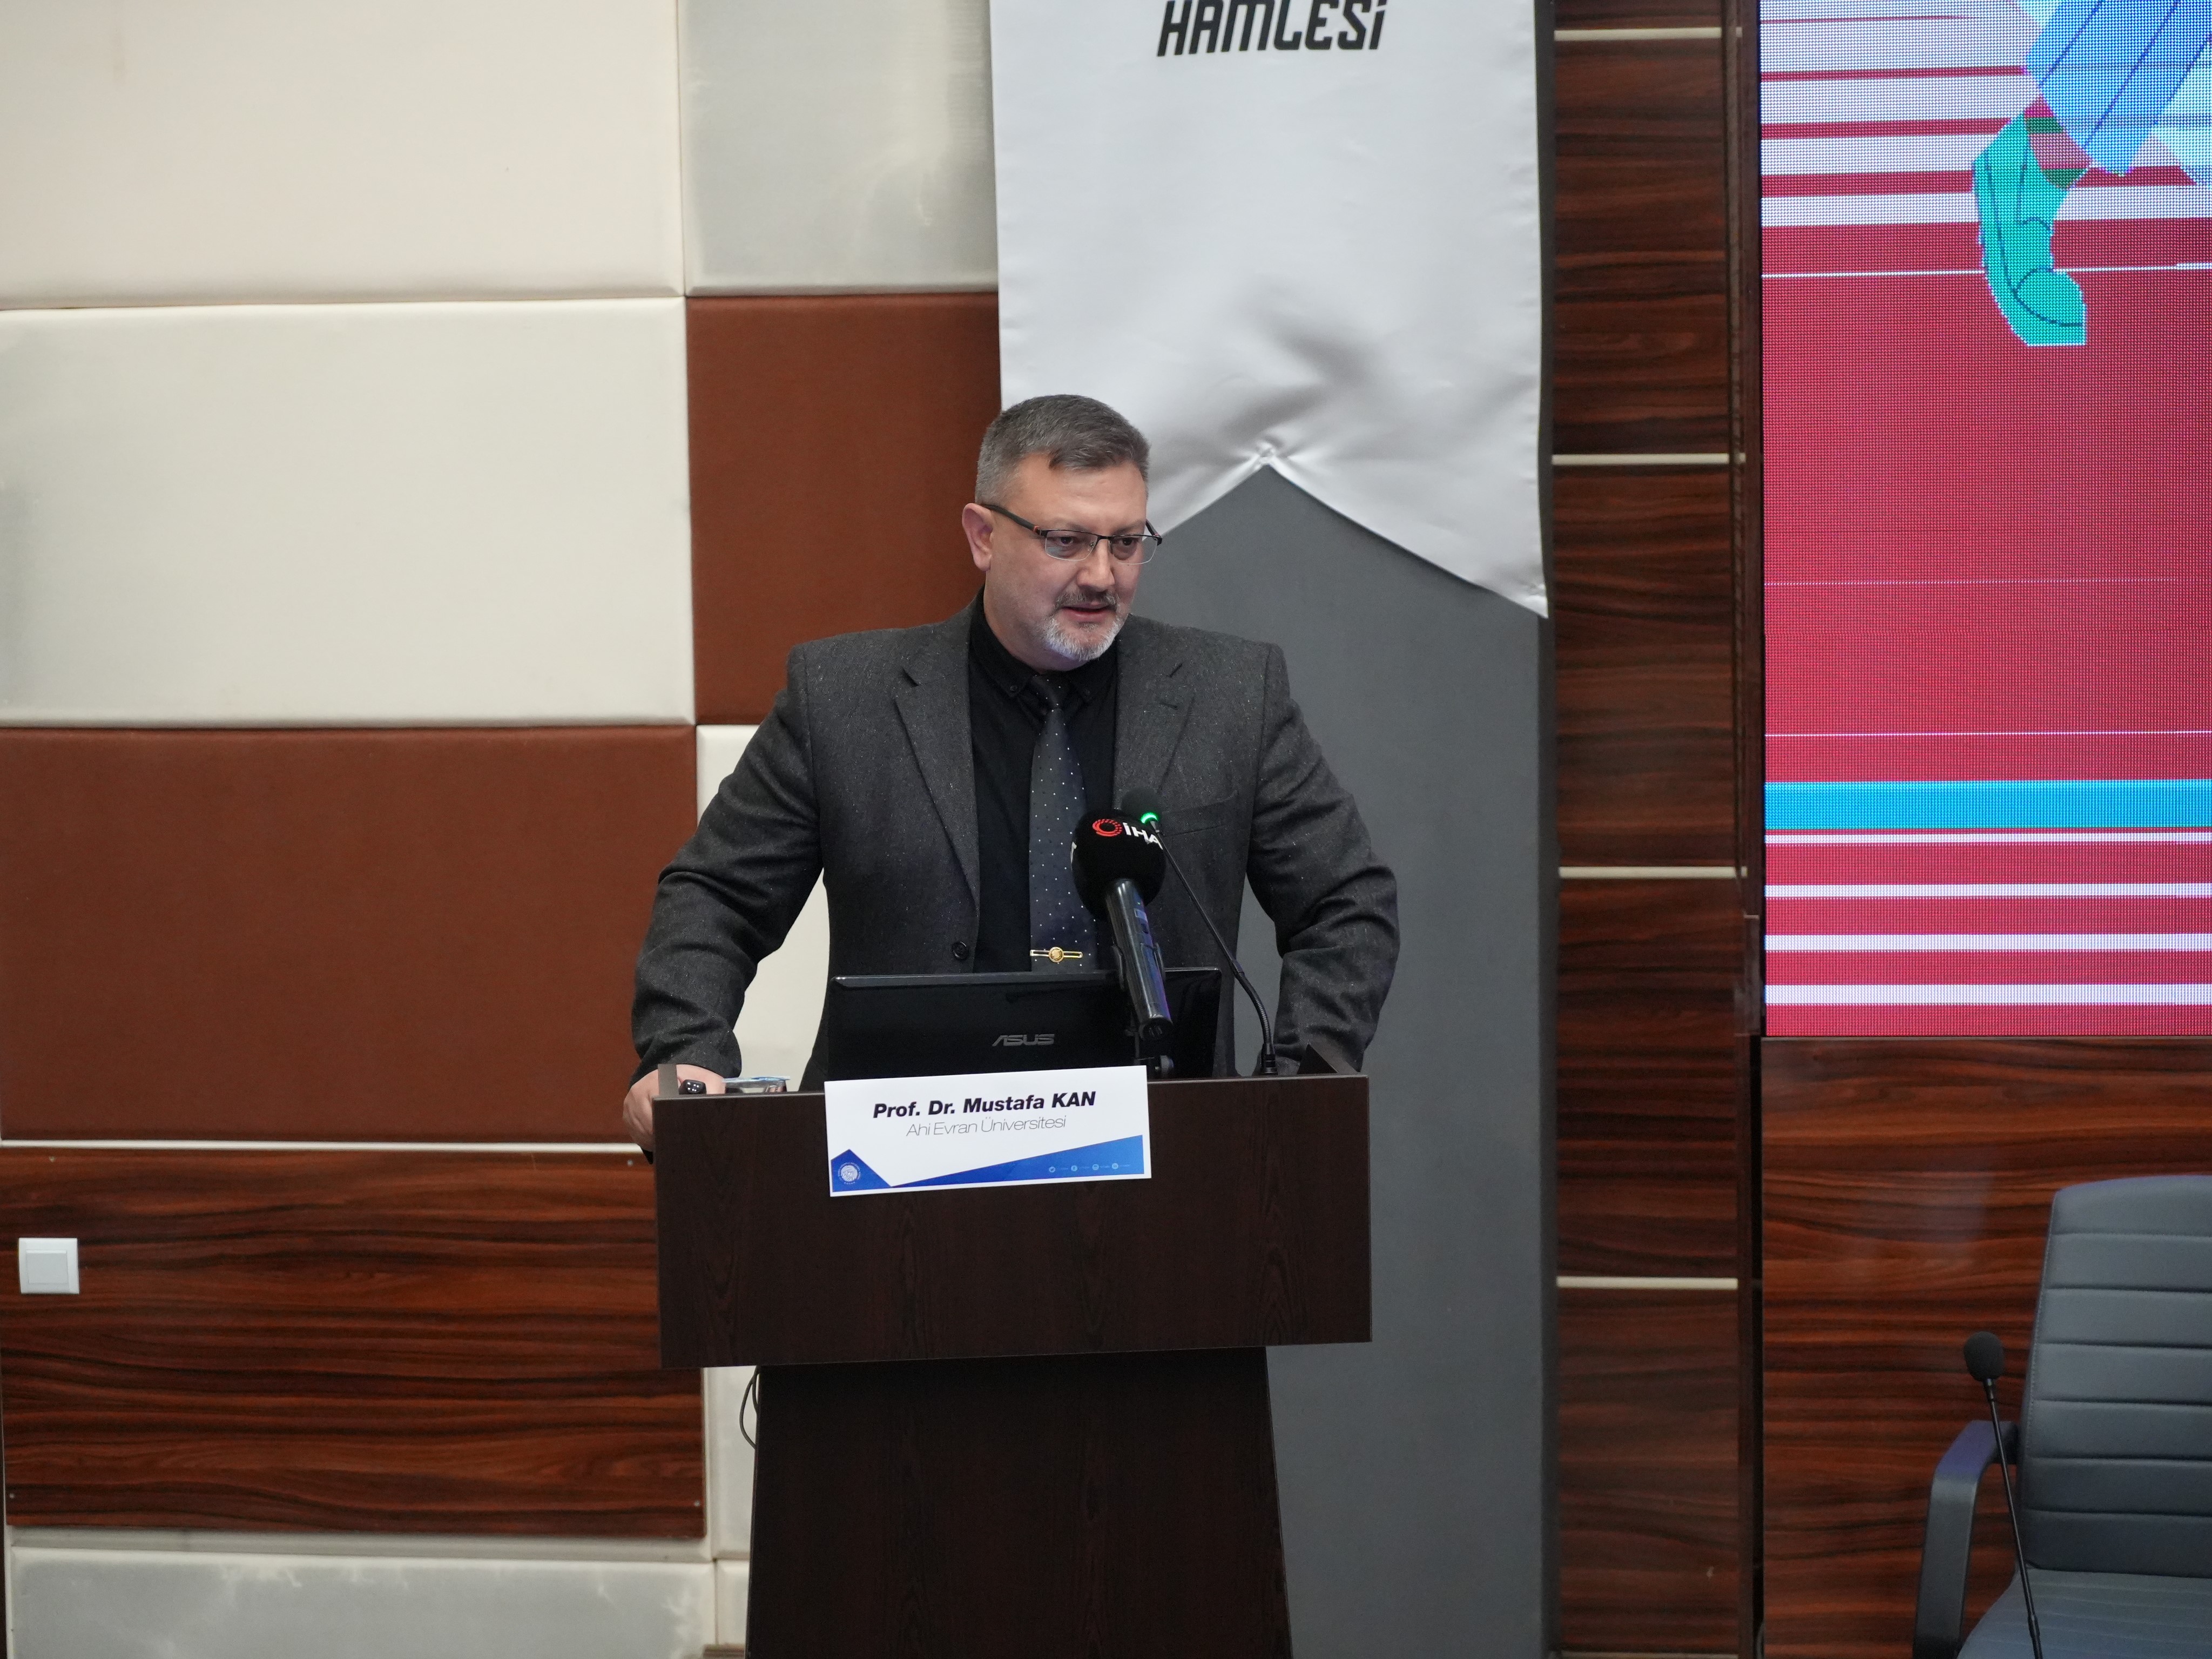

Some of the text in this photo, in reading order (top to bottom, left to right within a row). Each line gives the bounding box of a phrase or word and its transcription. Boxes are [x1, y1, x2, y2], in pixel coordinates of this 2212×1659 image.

[992, 1034, 1055, 1047] ASUS
[872, 1091, 1096, 1118] Prof. Dr. Mustafa KAN
[906, 1115, 1067, 1137] Ahi Evran Üniversitesi
